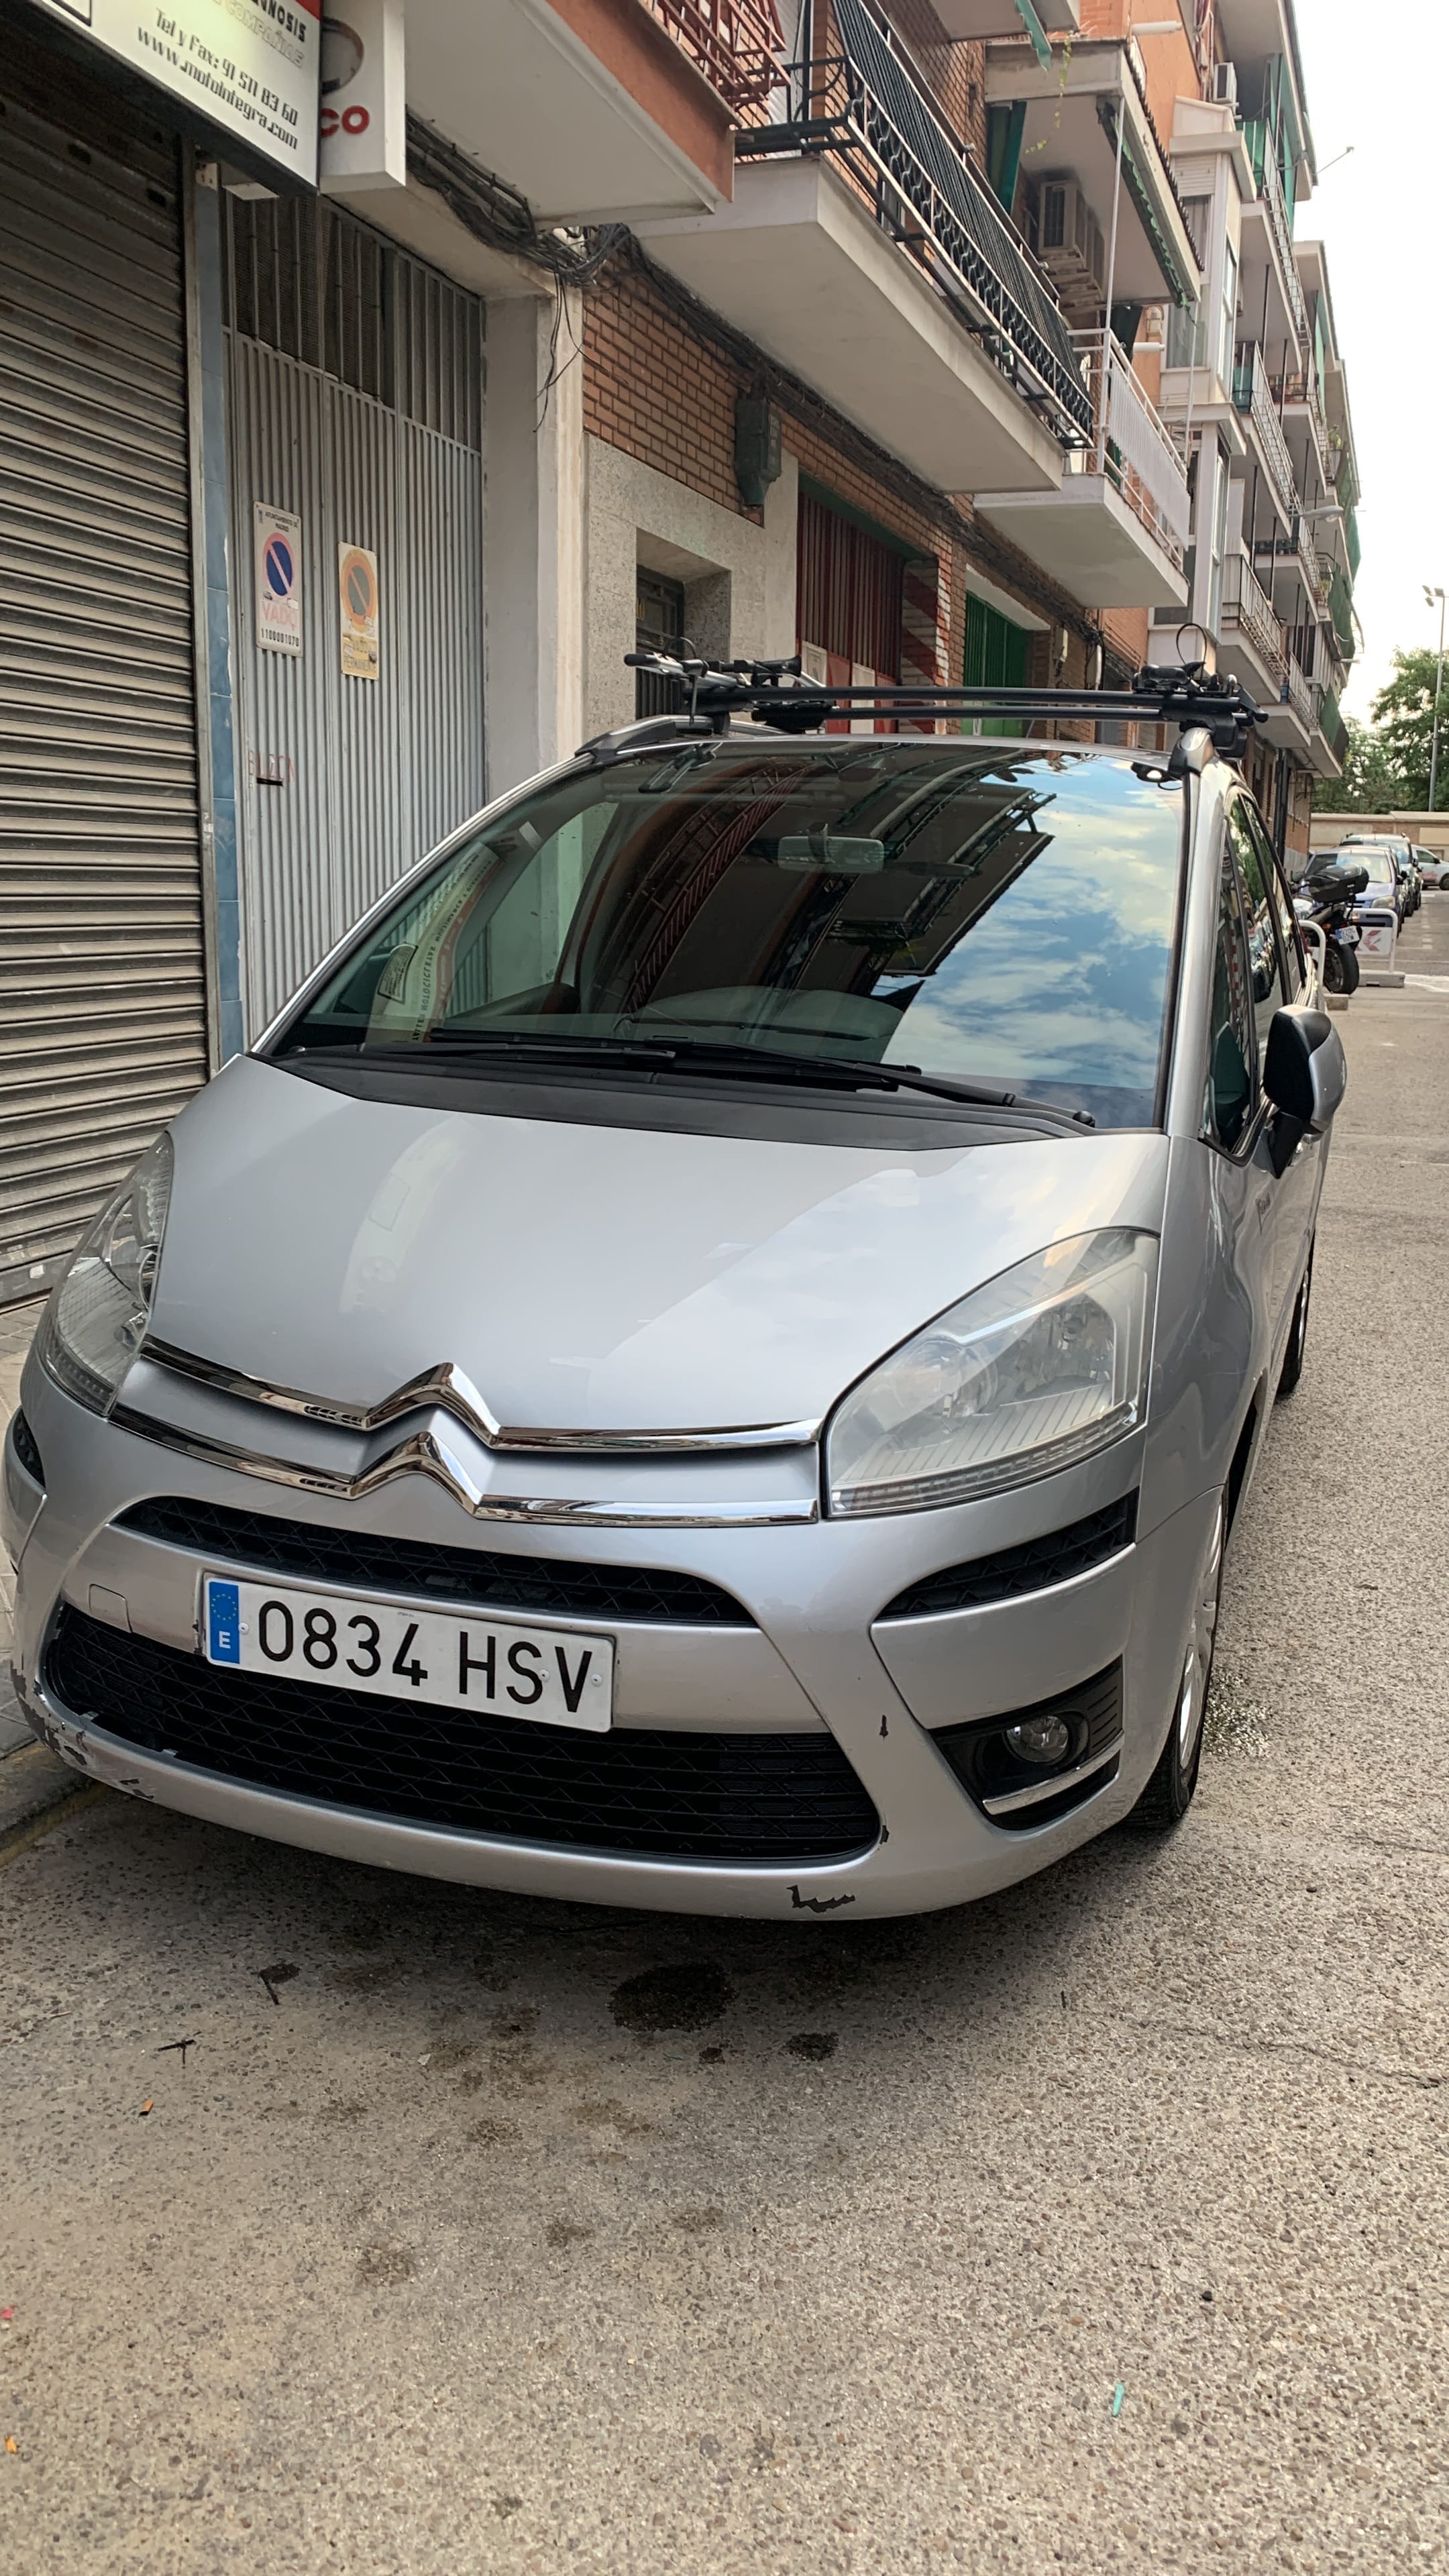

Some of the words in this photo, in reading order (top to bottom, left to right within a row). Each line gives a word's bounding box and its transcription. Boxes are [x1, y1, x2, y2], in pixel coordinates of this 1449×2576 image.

[156, 7, 176, 37] Tel
[177, 30, 187, 46] y
[189, 34, 219, 68] Fax:
[222, 58, 235, 80] 91
[238, 70, 258, 97] 511
[261, 87, 280, 112] 83
[282, 102, 299, 126] 60
[219, 1630, 231, 1649] E
[258, 1600, 428, 1686] 0834
[460, 1631, 592, 1713] HSV
